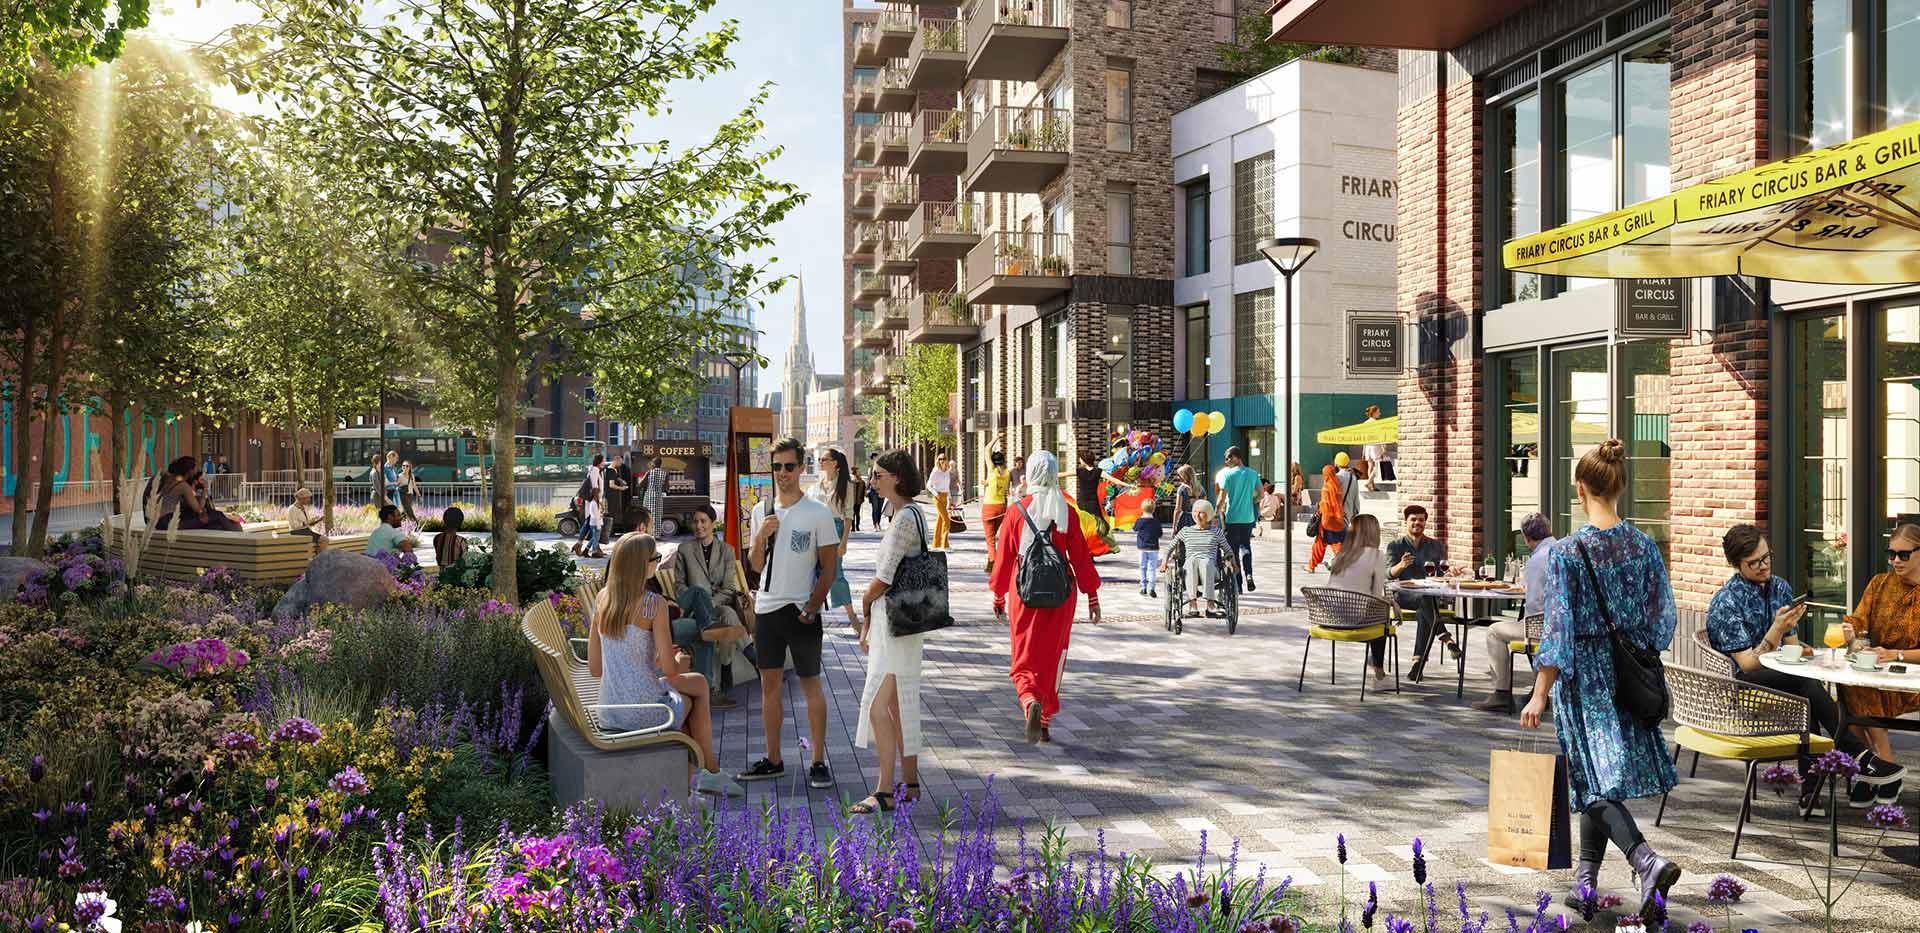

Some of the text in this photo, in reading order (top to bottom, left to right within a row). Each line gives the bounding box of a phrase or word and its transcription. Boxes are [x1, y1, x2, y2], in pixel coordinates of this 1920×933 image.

[1699, 187, 1746, 211] FRIARY
[1752, 171, 1809, 200] CIRCUS
[1815, 159, 1848, 184] BAR
[1855, 154, 1867, 172] &
[1343, 220, 1398, 243] CIRCU
[1516, 210, 1656, 261] FRIARY CIRCUS BAR & GRILL
[1635, 289, 1676, 300] CIRCUS
[1363, 328, 1390, 337] FRIARY
[1361, 339, 1392, 348] CIRCUS
[660, 447, 696, 456] COFFEE
